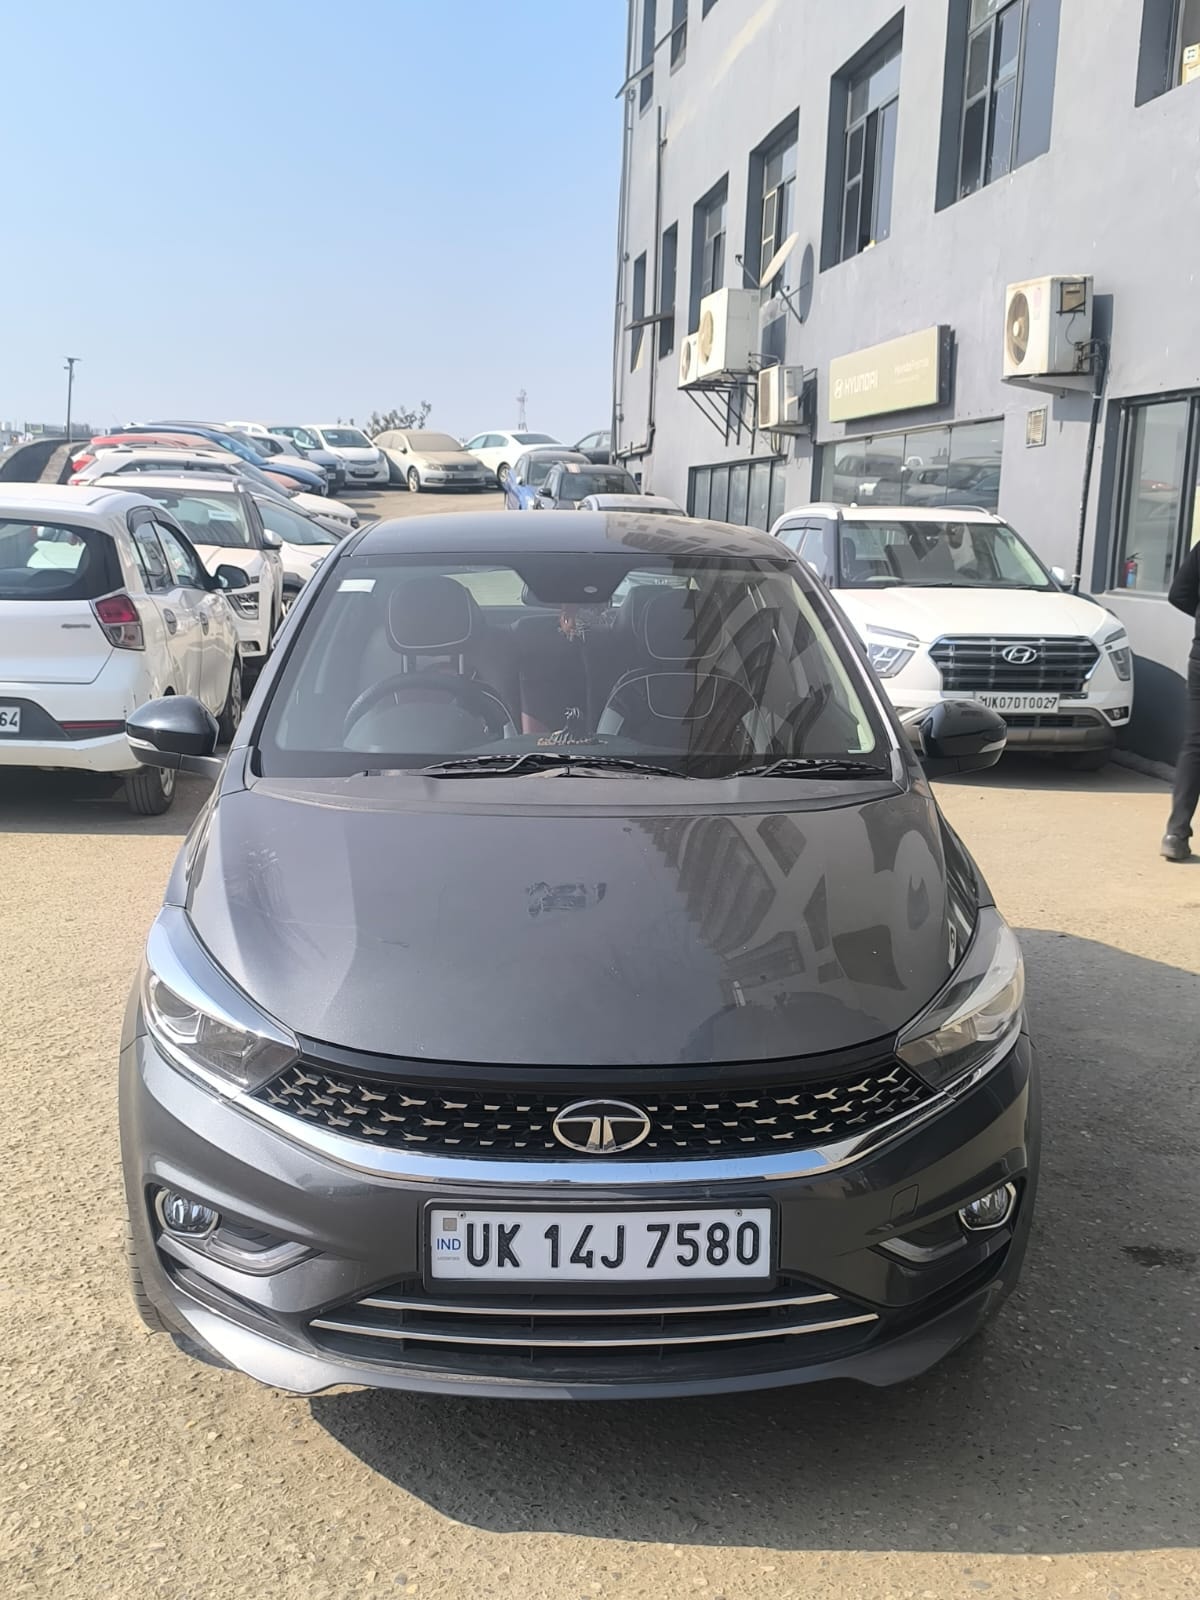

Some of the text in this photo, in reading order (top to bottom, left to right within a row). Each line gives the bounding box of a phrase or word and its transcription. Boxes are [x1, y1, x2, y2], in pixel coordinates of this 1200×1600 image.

[844, 369, 878, 394] HYUNDAI
[984, 696, 1057, 709] UK07DT0027
[436, 1237, 462, 1251] IND
[466, 1220, 760, 1269] UK 14J 7580
